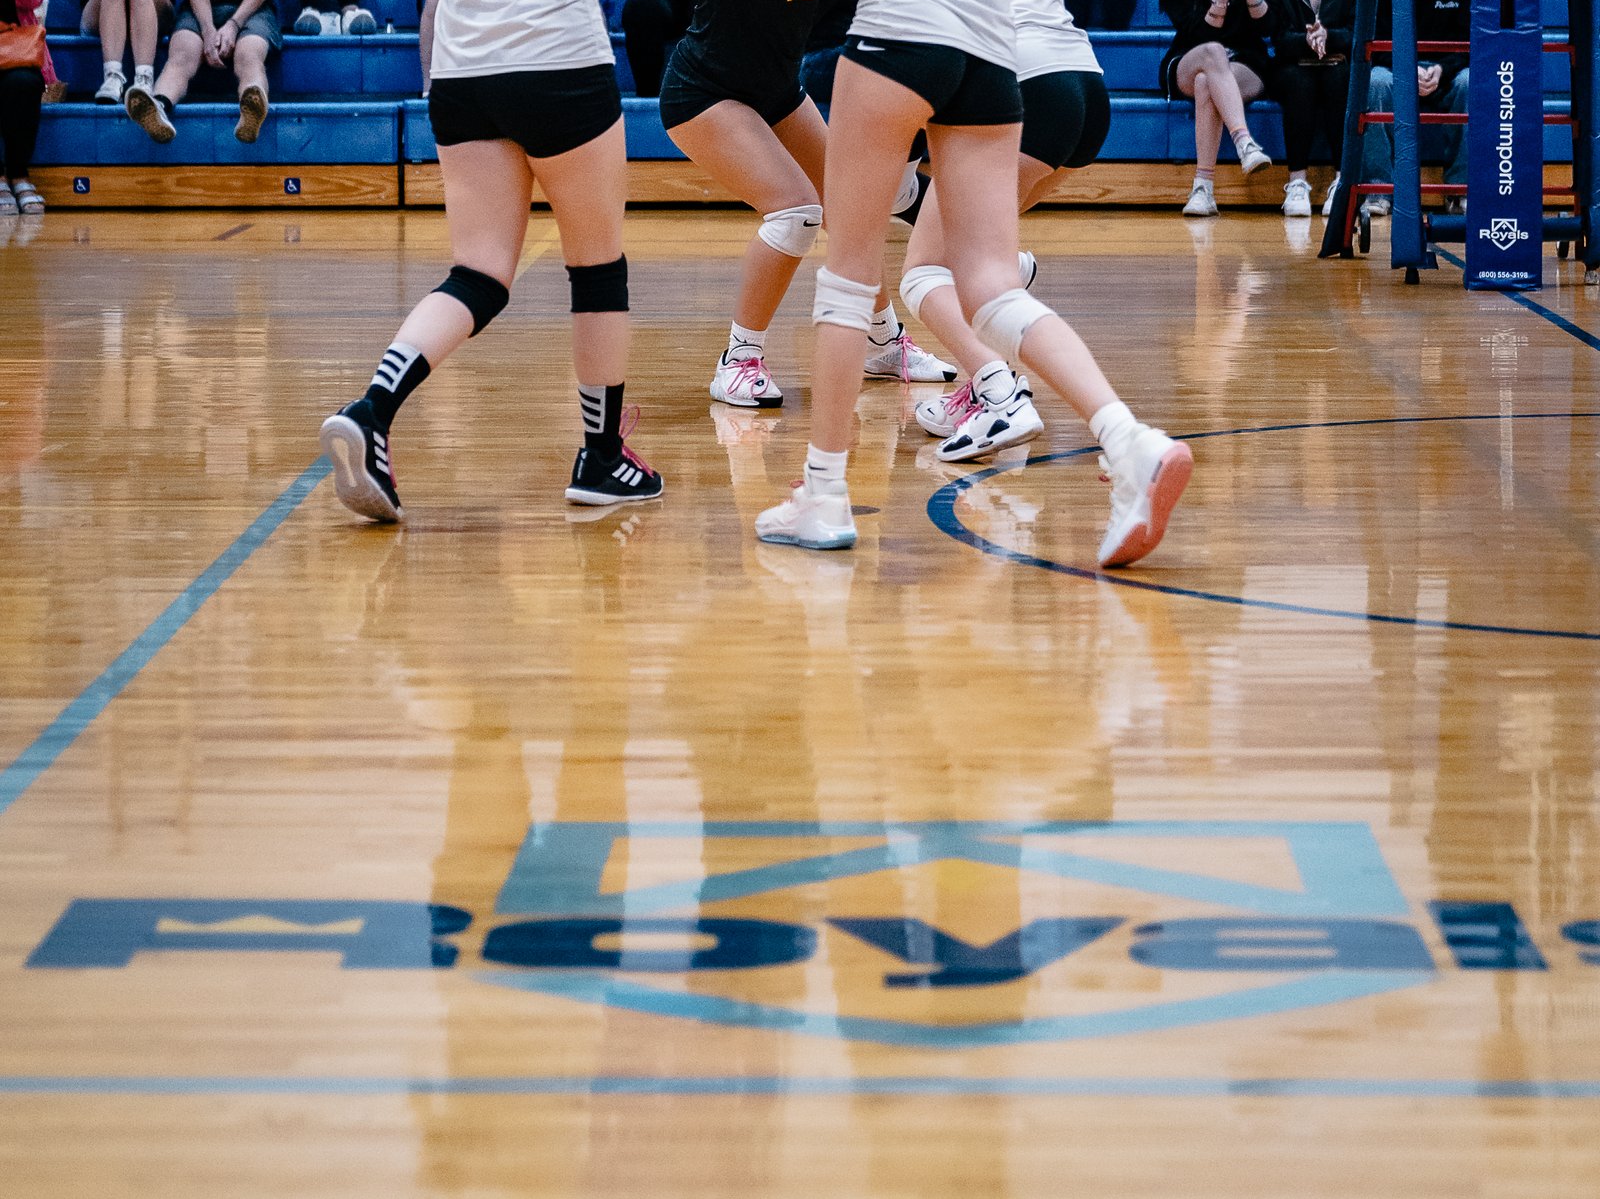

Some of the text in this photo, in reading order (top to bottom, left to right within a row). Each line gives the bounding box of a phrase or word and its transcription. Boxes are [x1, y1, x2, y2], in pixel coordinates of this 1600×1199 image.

[1495, 60, 1516, 196] sports imports
[1479, 228, 1529, 242] Royals
[1478, 270, 1529, 279] (800) 556-3198
[24, 897, 1600, 987] Royal
